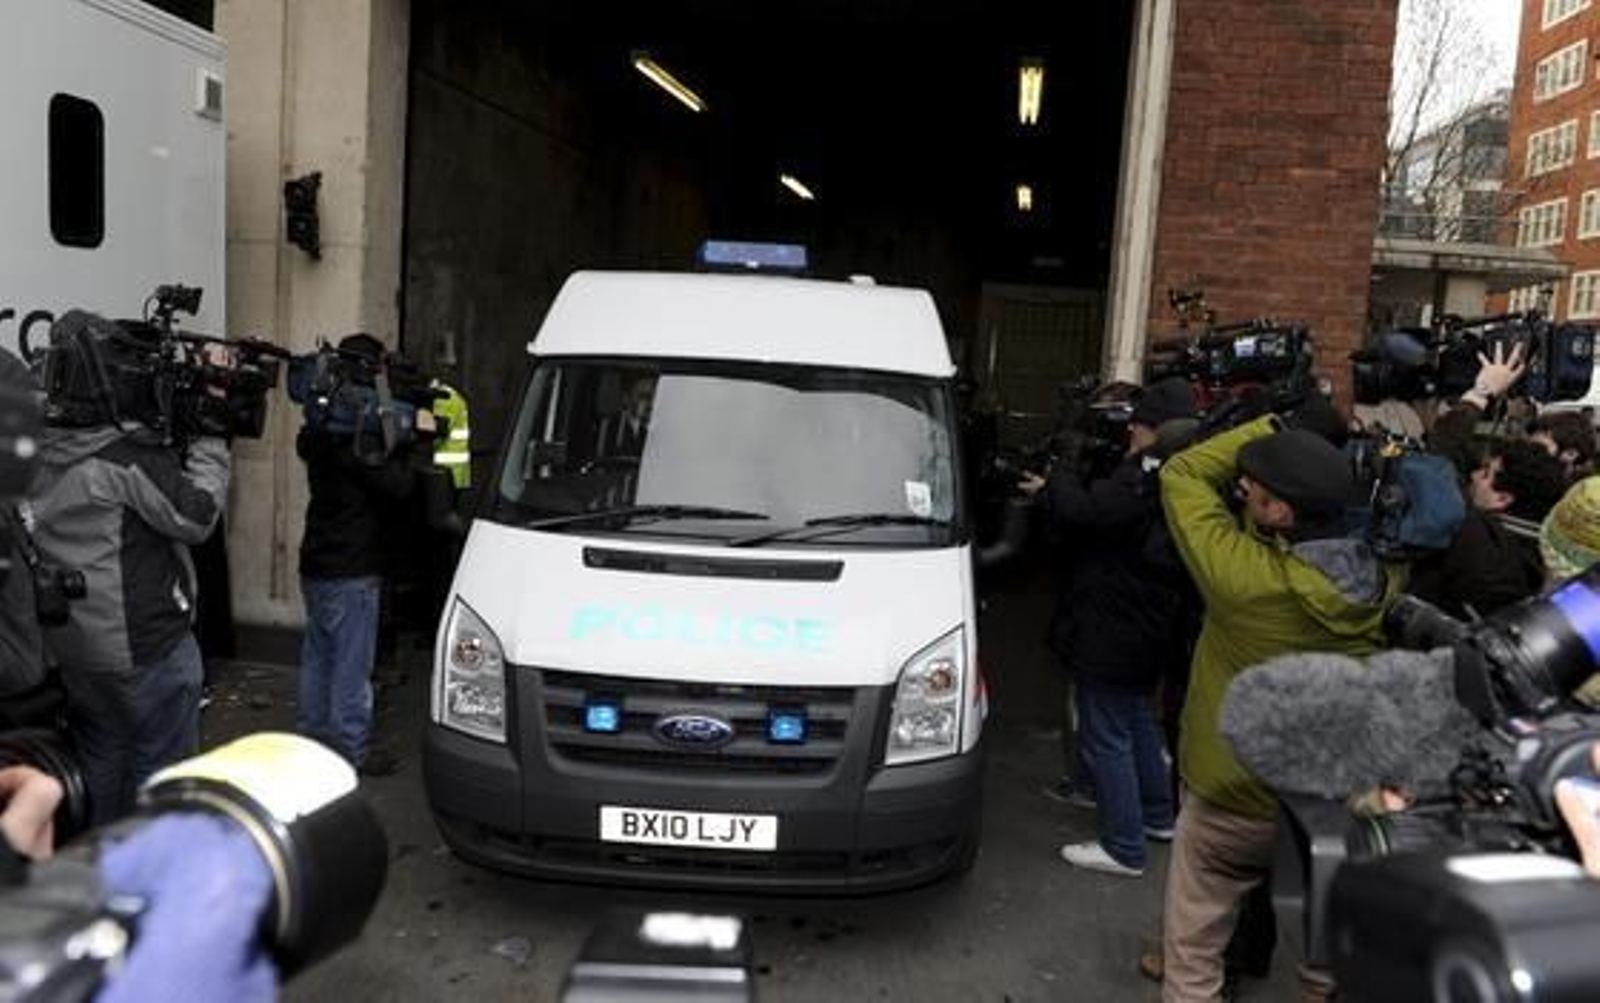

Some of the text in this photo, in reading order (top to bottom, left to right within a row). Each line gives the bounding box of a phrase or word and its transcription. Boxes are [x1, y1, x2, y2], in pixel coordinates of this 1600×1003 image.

[569, 600, 836, 656] POLICE
[621, 811, 757, 843] BX10 LJY
